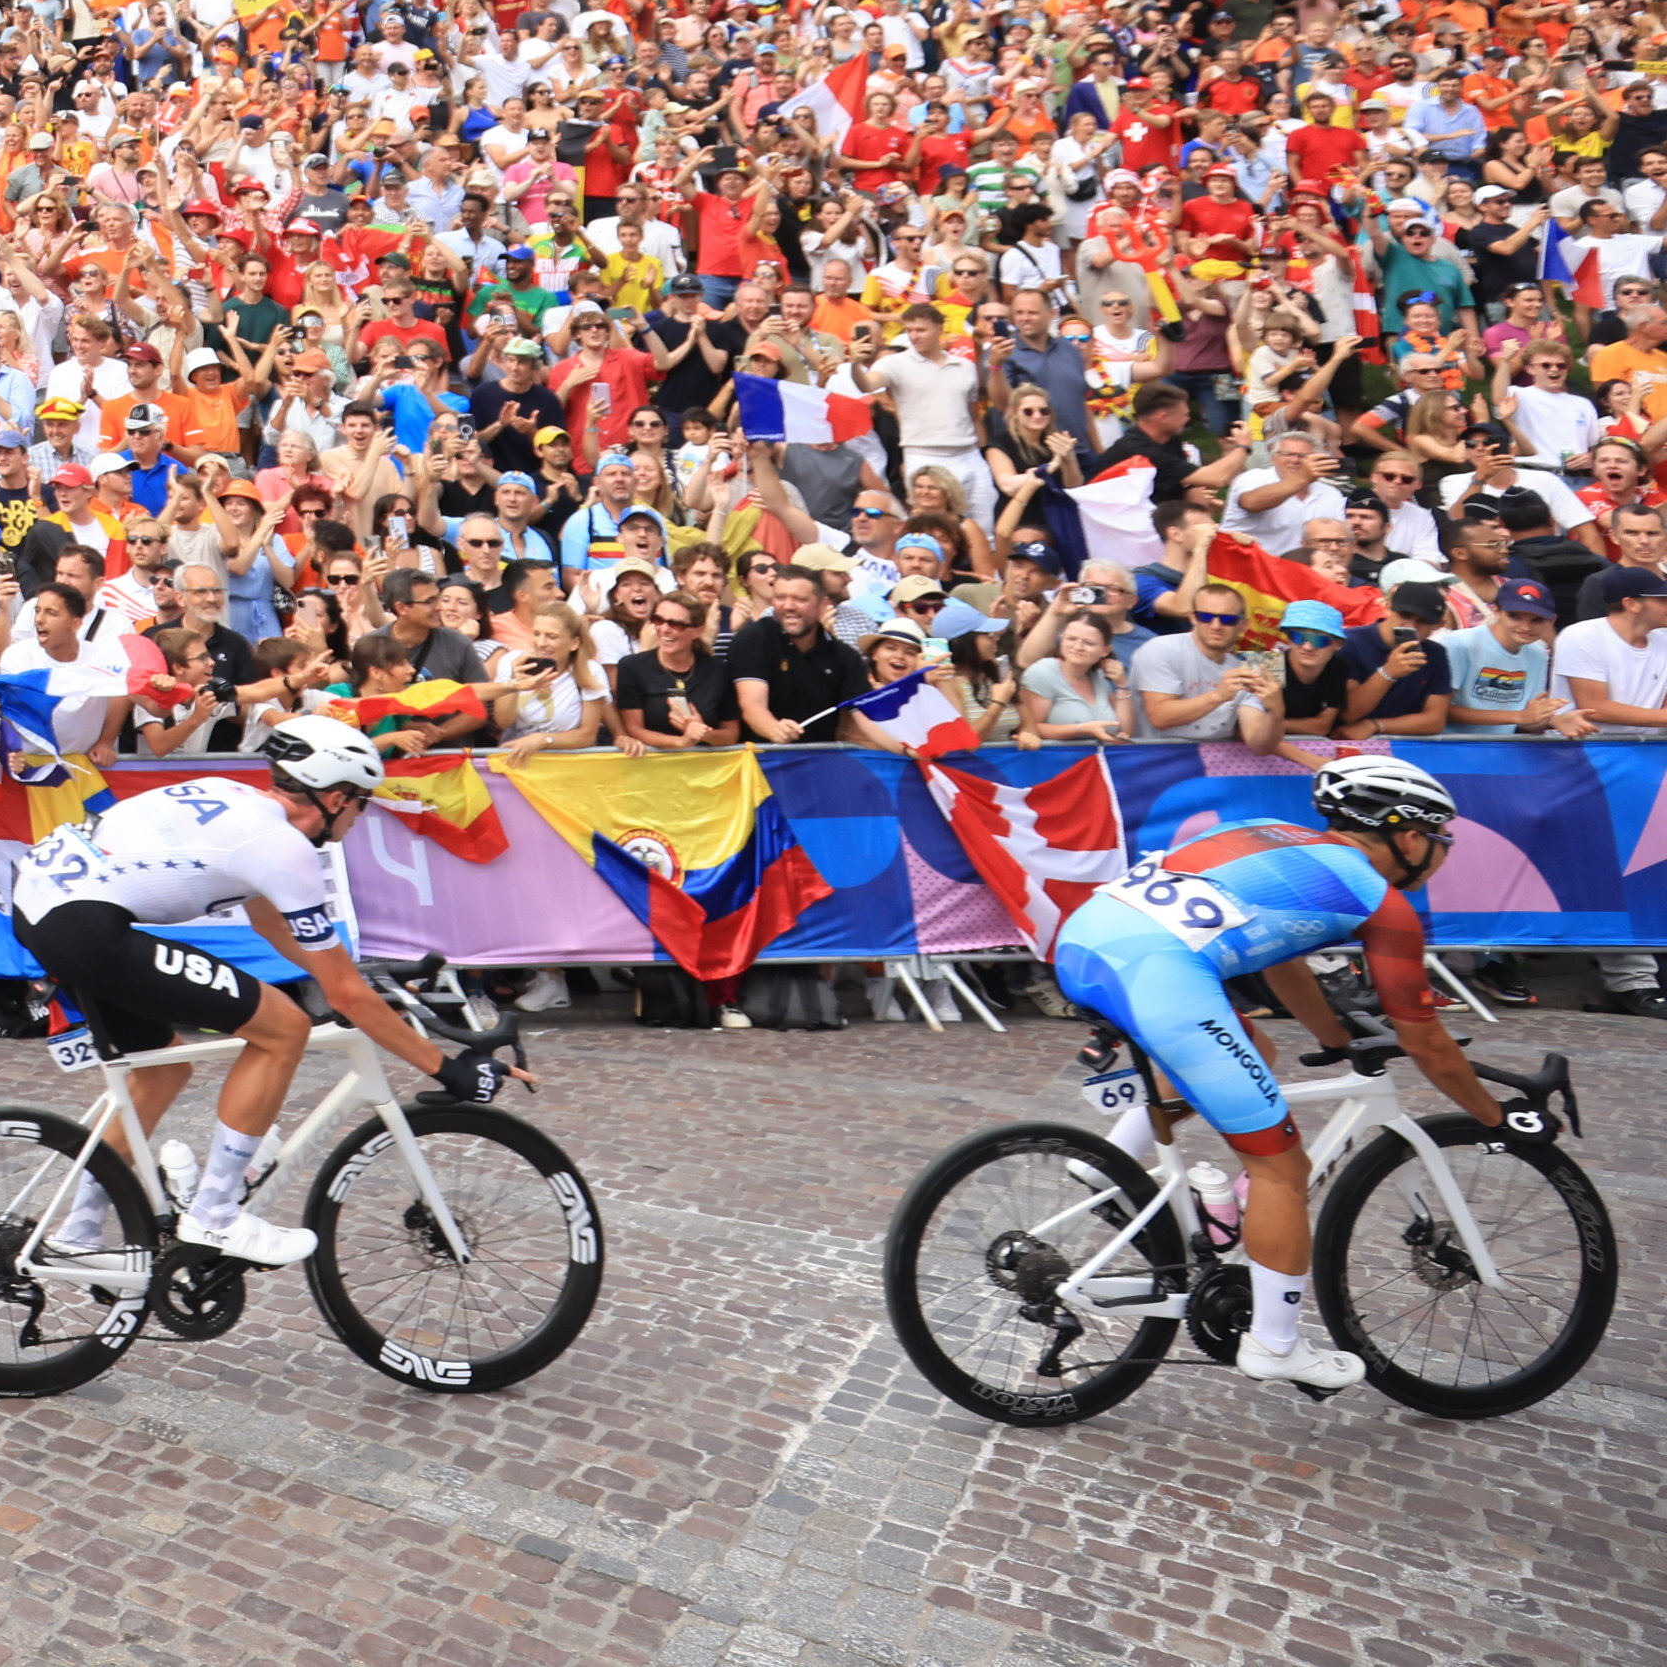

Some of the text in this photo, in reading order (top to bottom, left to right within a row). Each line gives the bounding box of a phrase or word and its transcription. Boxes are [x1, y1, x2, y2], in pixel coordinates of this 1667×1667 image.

[163, 781, 230, 826] SA
[154, 943, 241, 999] USA
[58, 1041, 93, 1066] 32
[1198, 1018, 1279, 1108] MONGOLIA
[474, 1062, 497, 1103] USA
[1101, 1083, 1136, 1108] 69
